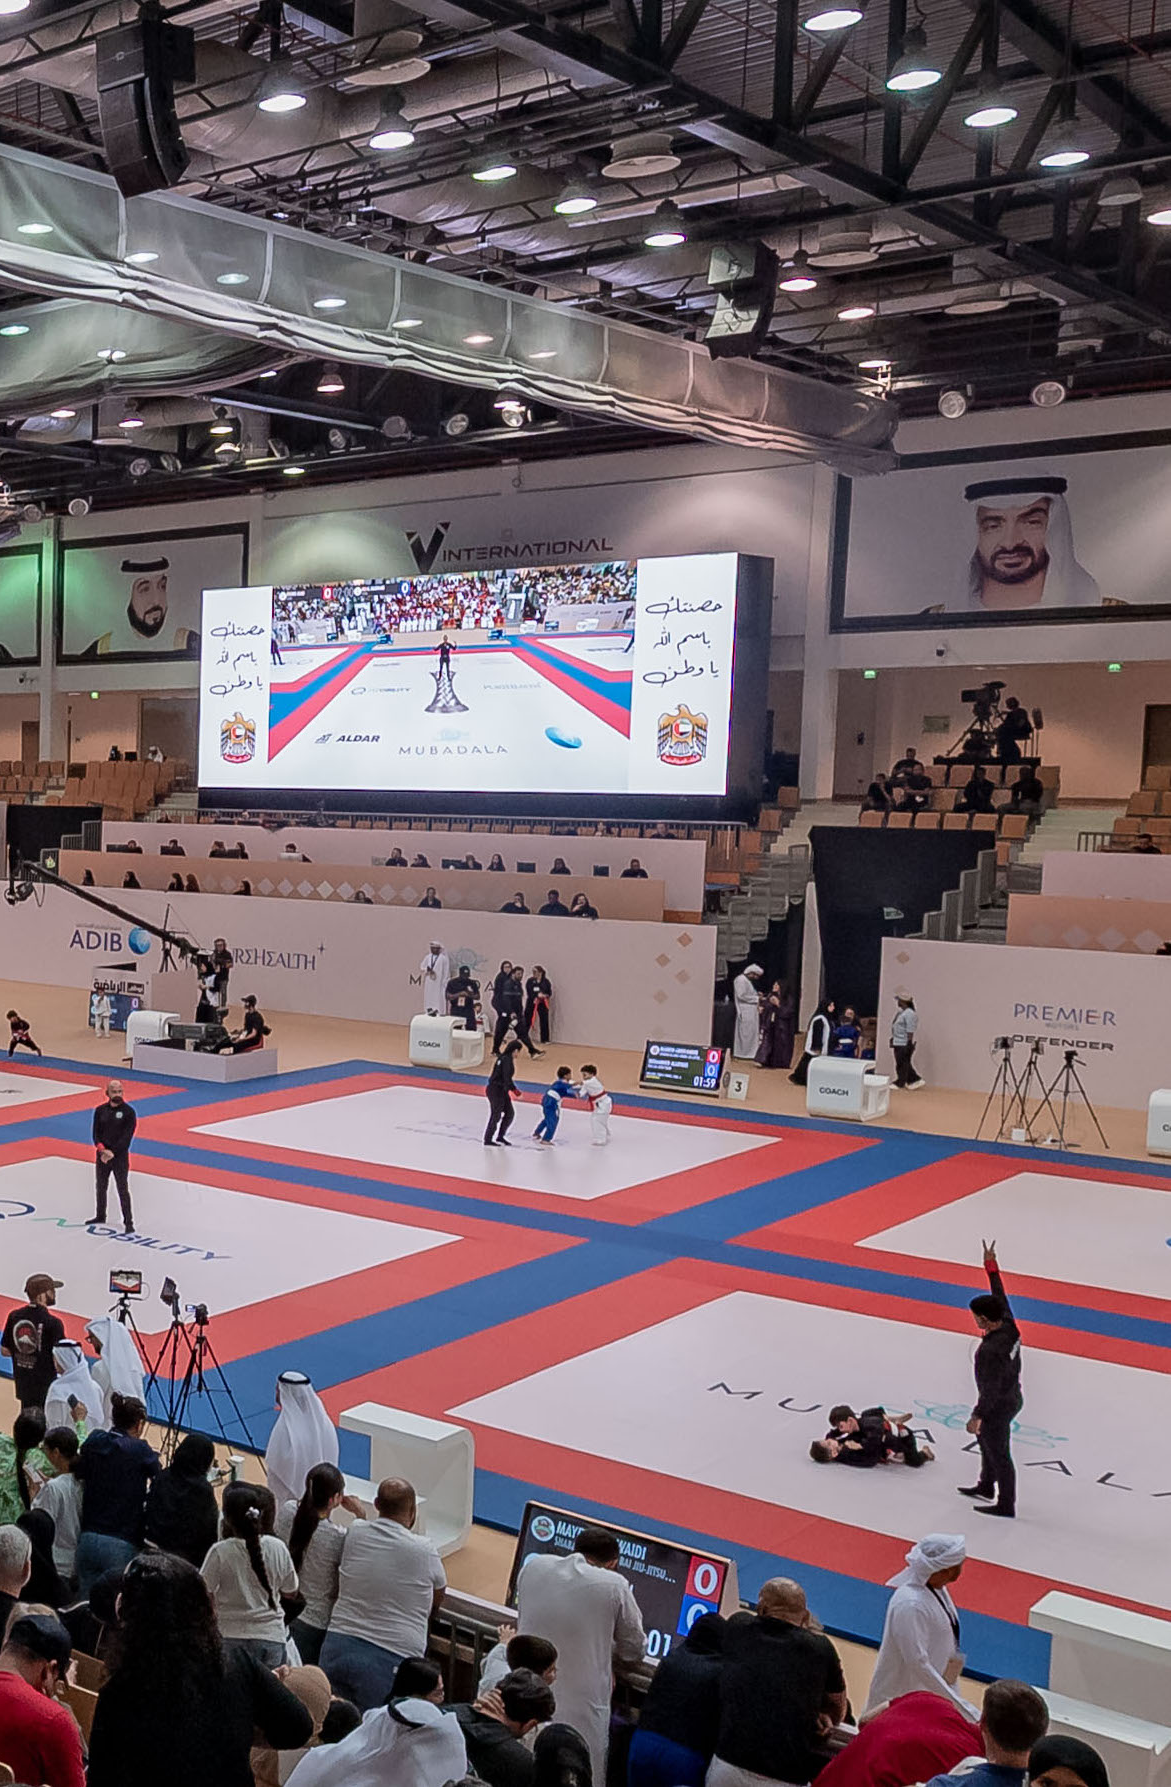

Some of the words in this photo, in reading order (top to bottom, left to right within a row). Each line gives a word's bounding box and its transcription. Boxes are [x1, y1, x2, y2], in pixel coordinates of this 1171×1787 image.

[442, 537, 613, 562] INTERNATIONAL
[652, 626, 671, 650] الله
[336, 734, 381, 744] ALDAR
[398, 744, 509, 757] MUBADALA
[70, 930, 123, 952] ADIB
[1014, 1003, 1116, 1026] PREMIER
[418, 1040, 441, 1049] COACH
[1011, 1034, 1115, 1051] DEFENDER
[710, 1051, 718, 1063] 0
[707, 1064, 716, 1076] 0
[693, 1076, 716, 1088] 01:59
[734, 1081, 743, 1092] 3
[819, 1086, 849, 1096] COACH
[694, 1563, 718, 1596] 0
[646, 1629, 672, 1657] 01
